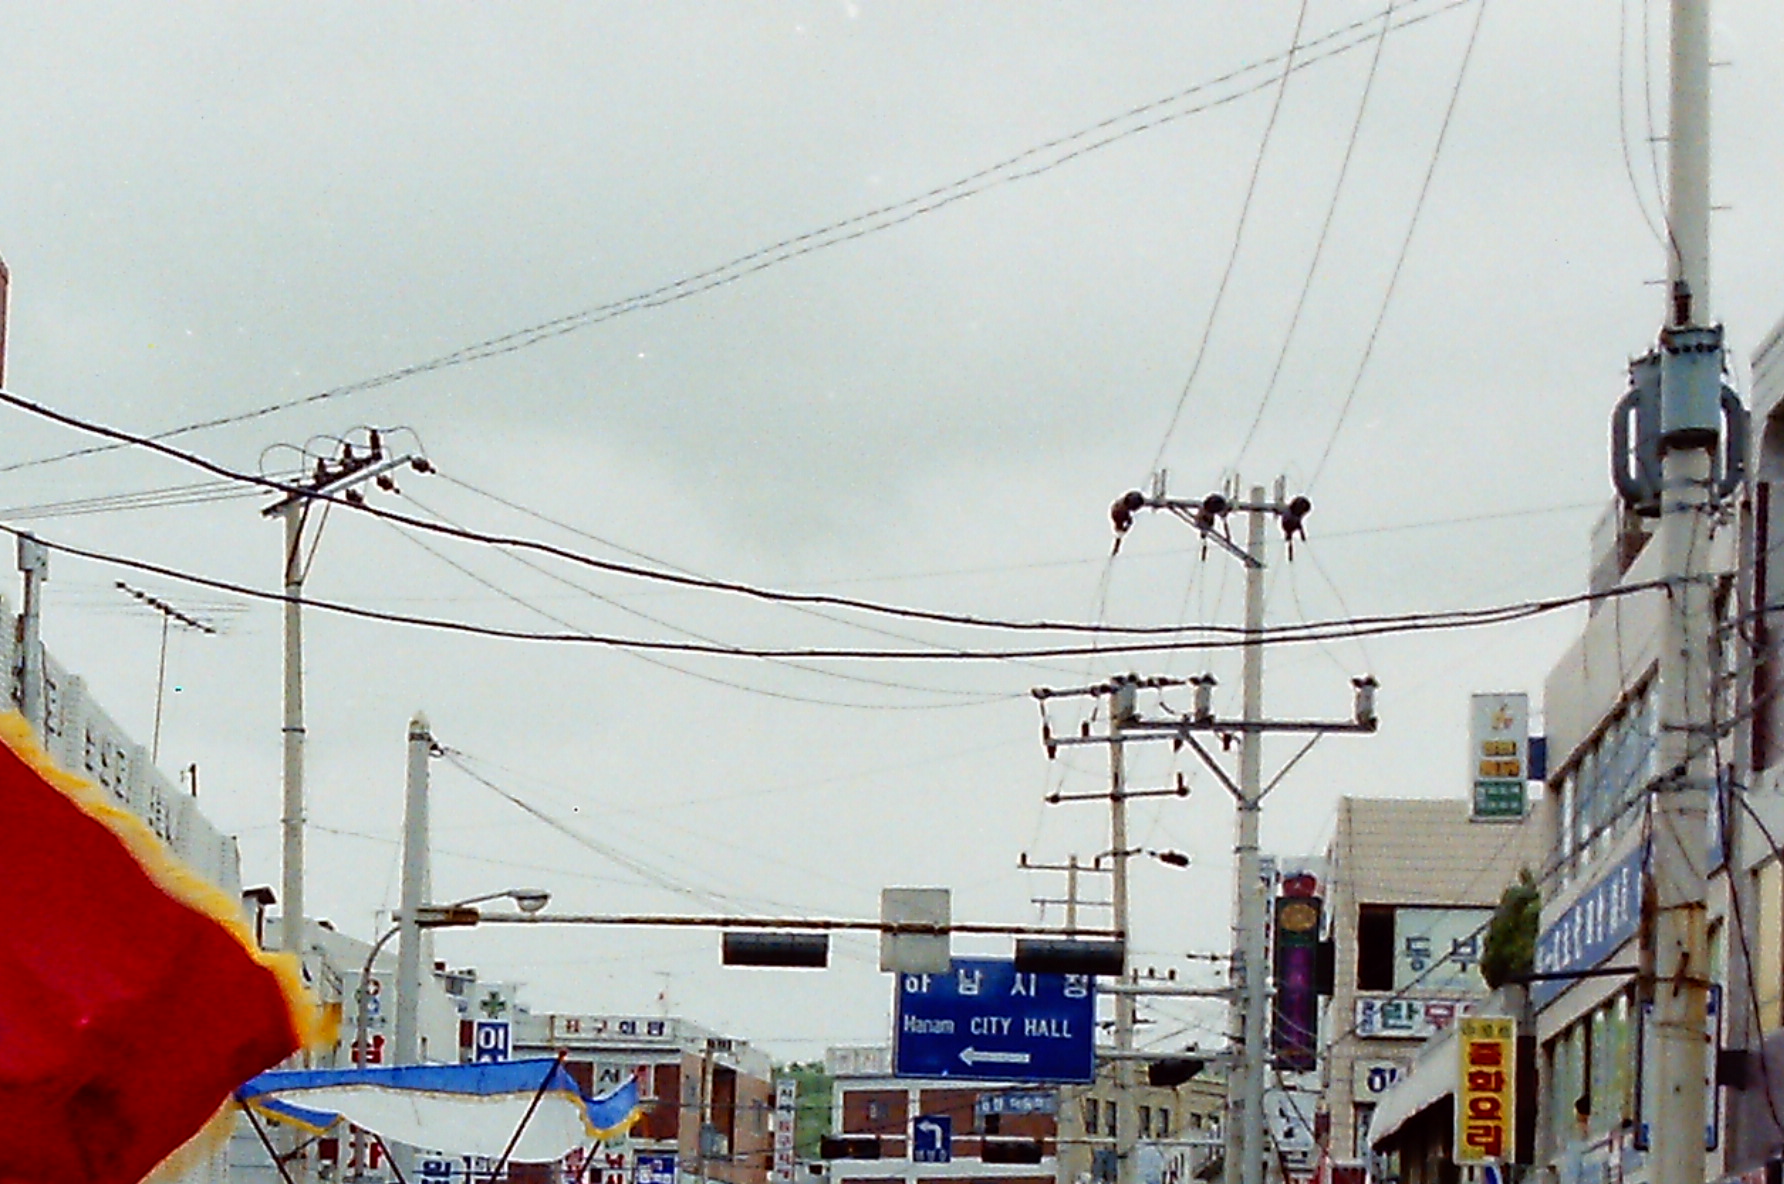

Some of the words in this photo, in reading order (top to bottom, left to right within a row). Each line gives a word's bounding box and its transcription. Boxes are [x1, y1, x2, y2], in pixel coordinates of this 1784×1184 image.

[903, 1014, 956, 1034] Hanam
[970, 1016, 1013, 1036] CITY
[1023, 1018, 1074, 1038] HALL
